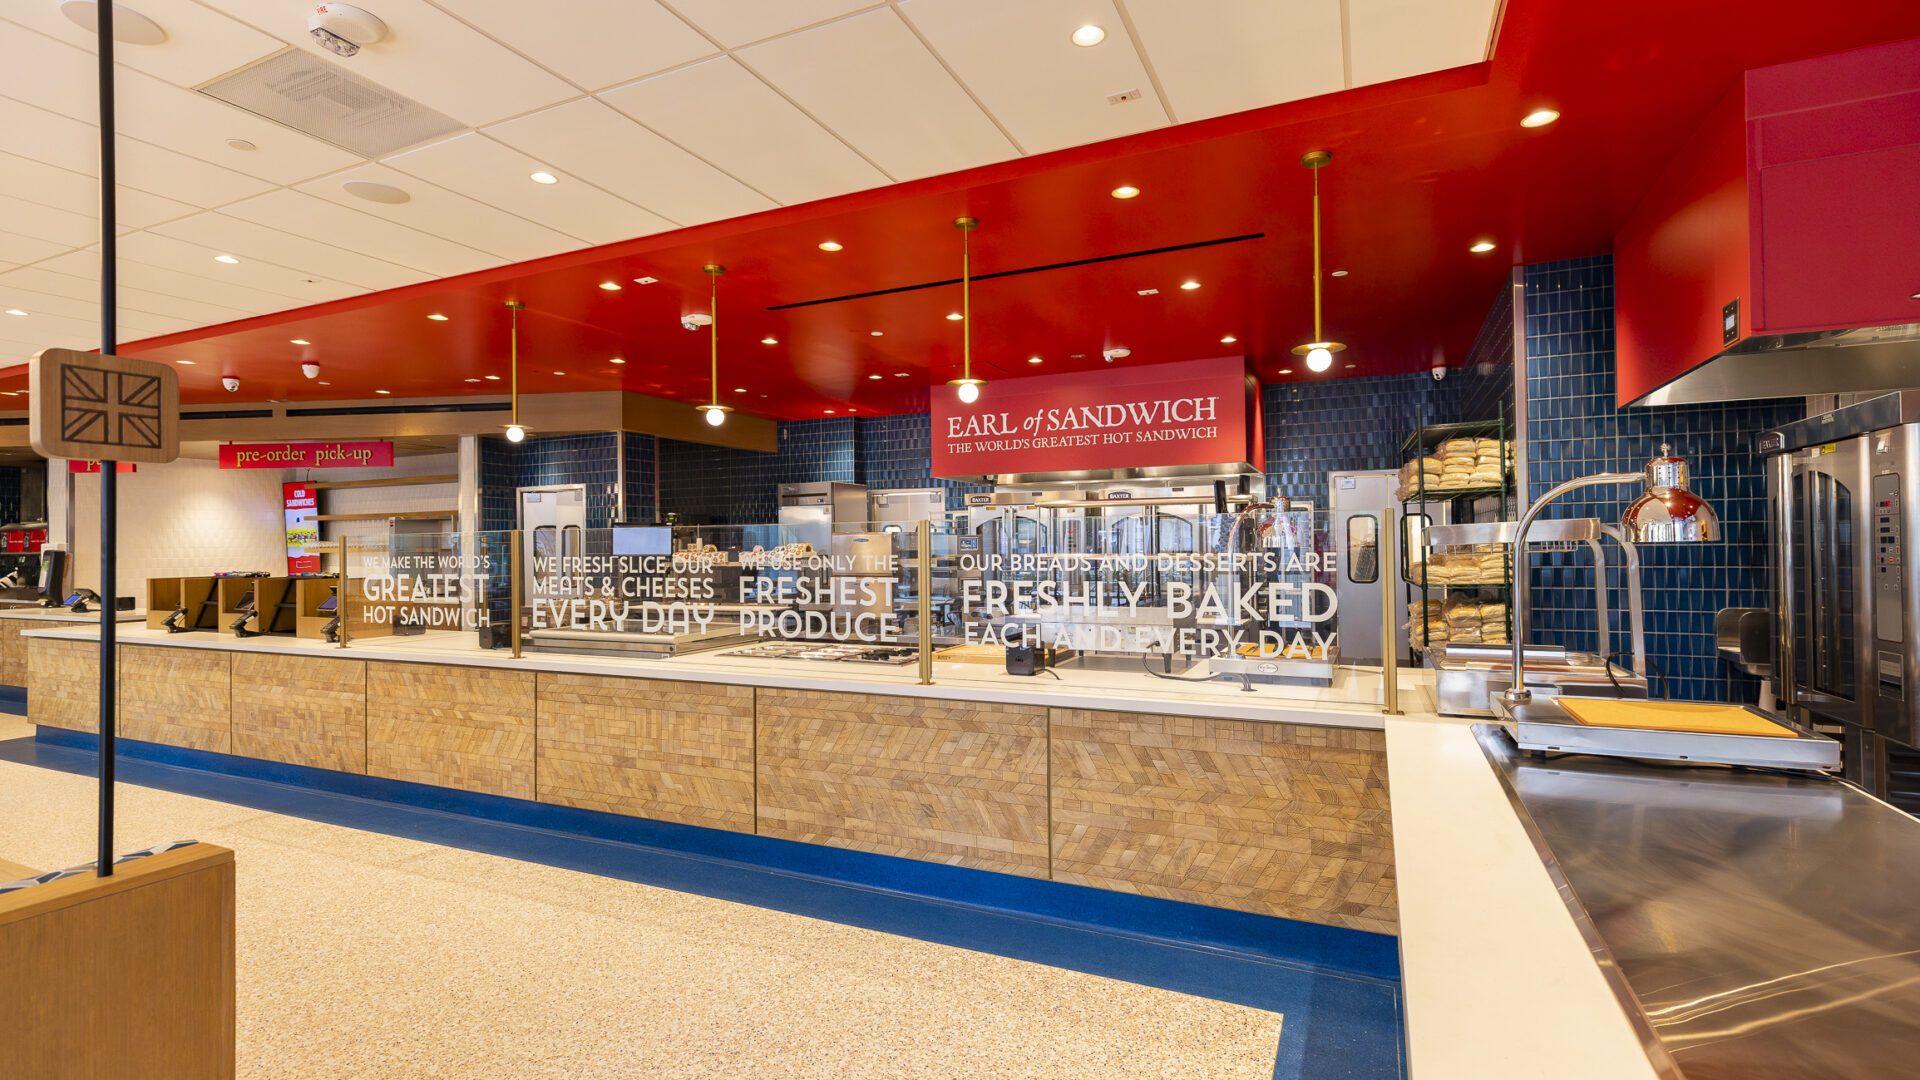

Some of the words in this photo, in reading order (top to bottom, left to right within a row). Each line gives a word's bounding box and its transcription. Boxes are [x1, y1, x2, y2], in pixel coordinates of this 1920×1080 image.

[947, 412, 1018, 438] EARL
[1022, 408, 1045, 437] of
[1046, 396, 1218, 431] SANDWICH
[948, 442, 972, 454] THE
[974, 437, 1030, 452] WORLD'S
[1032, 434, 1100, 449] GREATEST
[1103, 431, 1133, 443] HOT
[1135, 426, 1218, 442] SANDWICH
[236, 444, 306, 467] pre-order
[315, 444, 372, 466] pick-up
[1108, 491, 1130, 499] BAXTER
[363, 555, 378, 568] WE
[382, 555, 411, 568] MAKE
[413, 555, 435, 568] THE
[438, 555, 490, 568] WORLD'S
[533, 556, 557, 573] WE
[562, 556, 614, 573] FRESH
[619, 556, 666, 574] SLICE
[672, 557, 713, 574] OUR
[741, 555, 765, 571] WE
[771, 555, 801, 571] USE
[807, 555, 857, 571] ONLY
[862, 555, 899, 571] THE
[959, 553, 1003, 572] OUR
[1010, 553, 1092, 572] BREADS
[1099, 553, 1148, 572] AND
[1157, 552, 1277, 572] DESSERTS
[1285, 552, 1337, 572] ARE
[363, 574, 490, 603] GREATEST
[532, 576, 594, 596] MEATS
[601, 576, 615, 597] &
[621, 576, 714, 599] CHEESES
[739, 575, 899, 607] FRESHEST
[963, 580, 1148, 618] FRESHLY
[1167, 581, 1338, 623] BAKED
[363, 605, 396, 624] HOT
[400, 606, 490, 628] SANDWICH
[532, 598, 630, 632] EVERY
[642, 600, 714, 635] DAY
[739, 609, 898, 643] PRODUCE
[964, 621, 1041, 649] EACH
[1052, 623, 1122, 651] AND
[1135, 626, 1245, 660] EVERY
[1259, 630, 1337, 661] DAY
